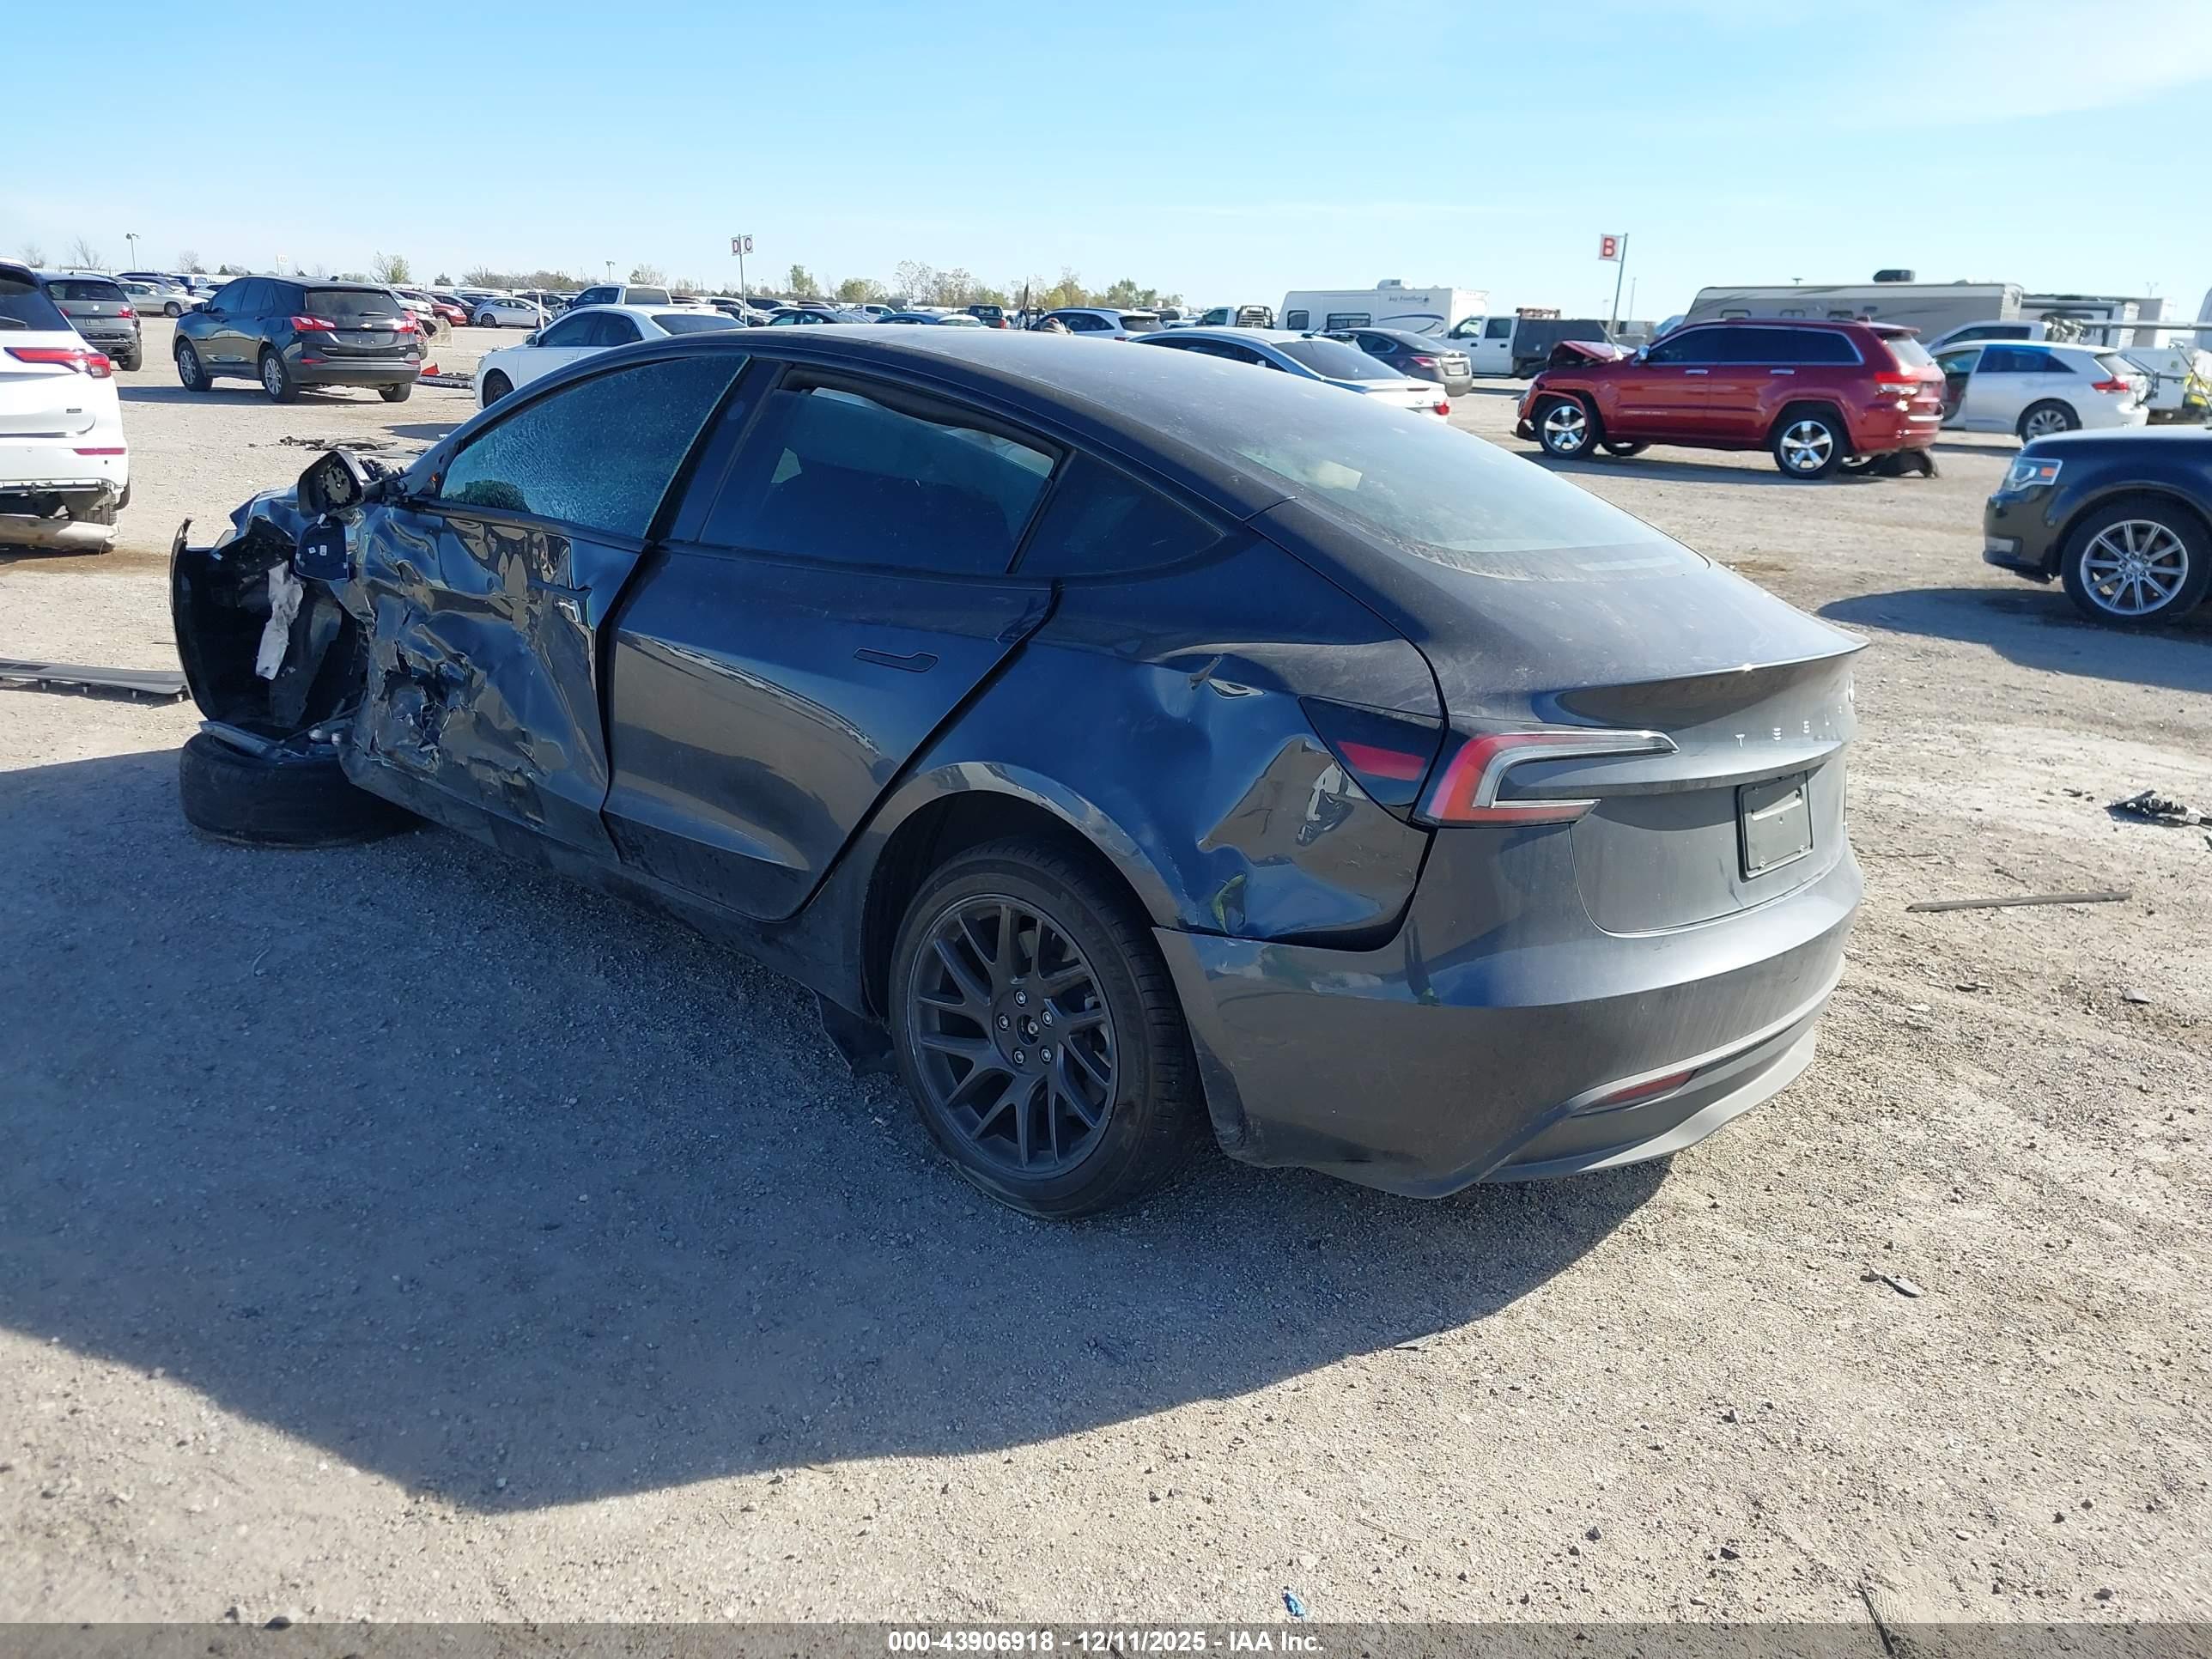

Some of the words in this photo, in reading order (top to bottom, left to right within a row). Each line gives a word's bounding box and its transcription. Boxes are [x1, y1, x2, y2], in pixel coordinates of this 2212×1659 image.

[732, 240, 739, 253] D
[744, 237, 752, 251] C
[1602, 237, 1615, 257] B
